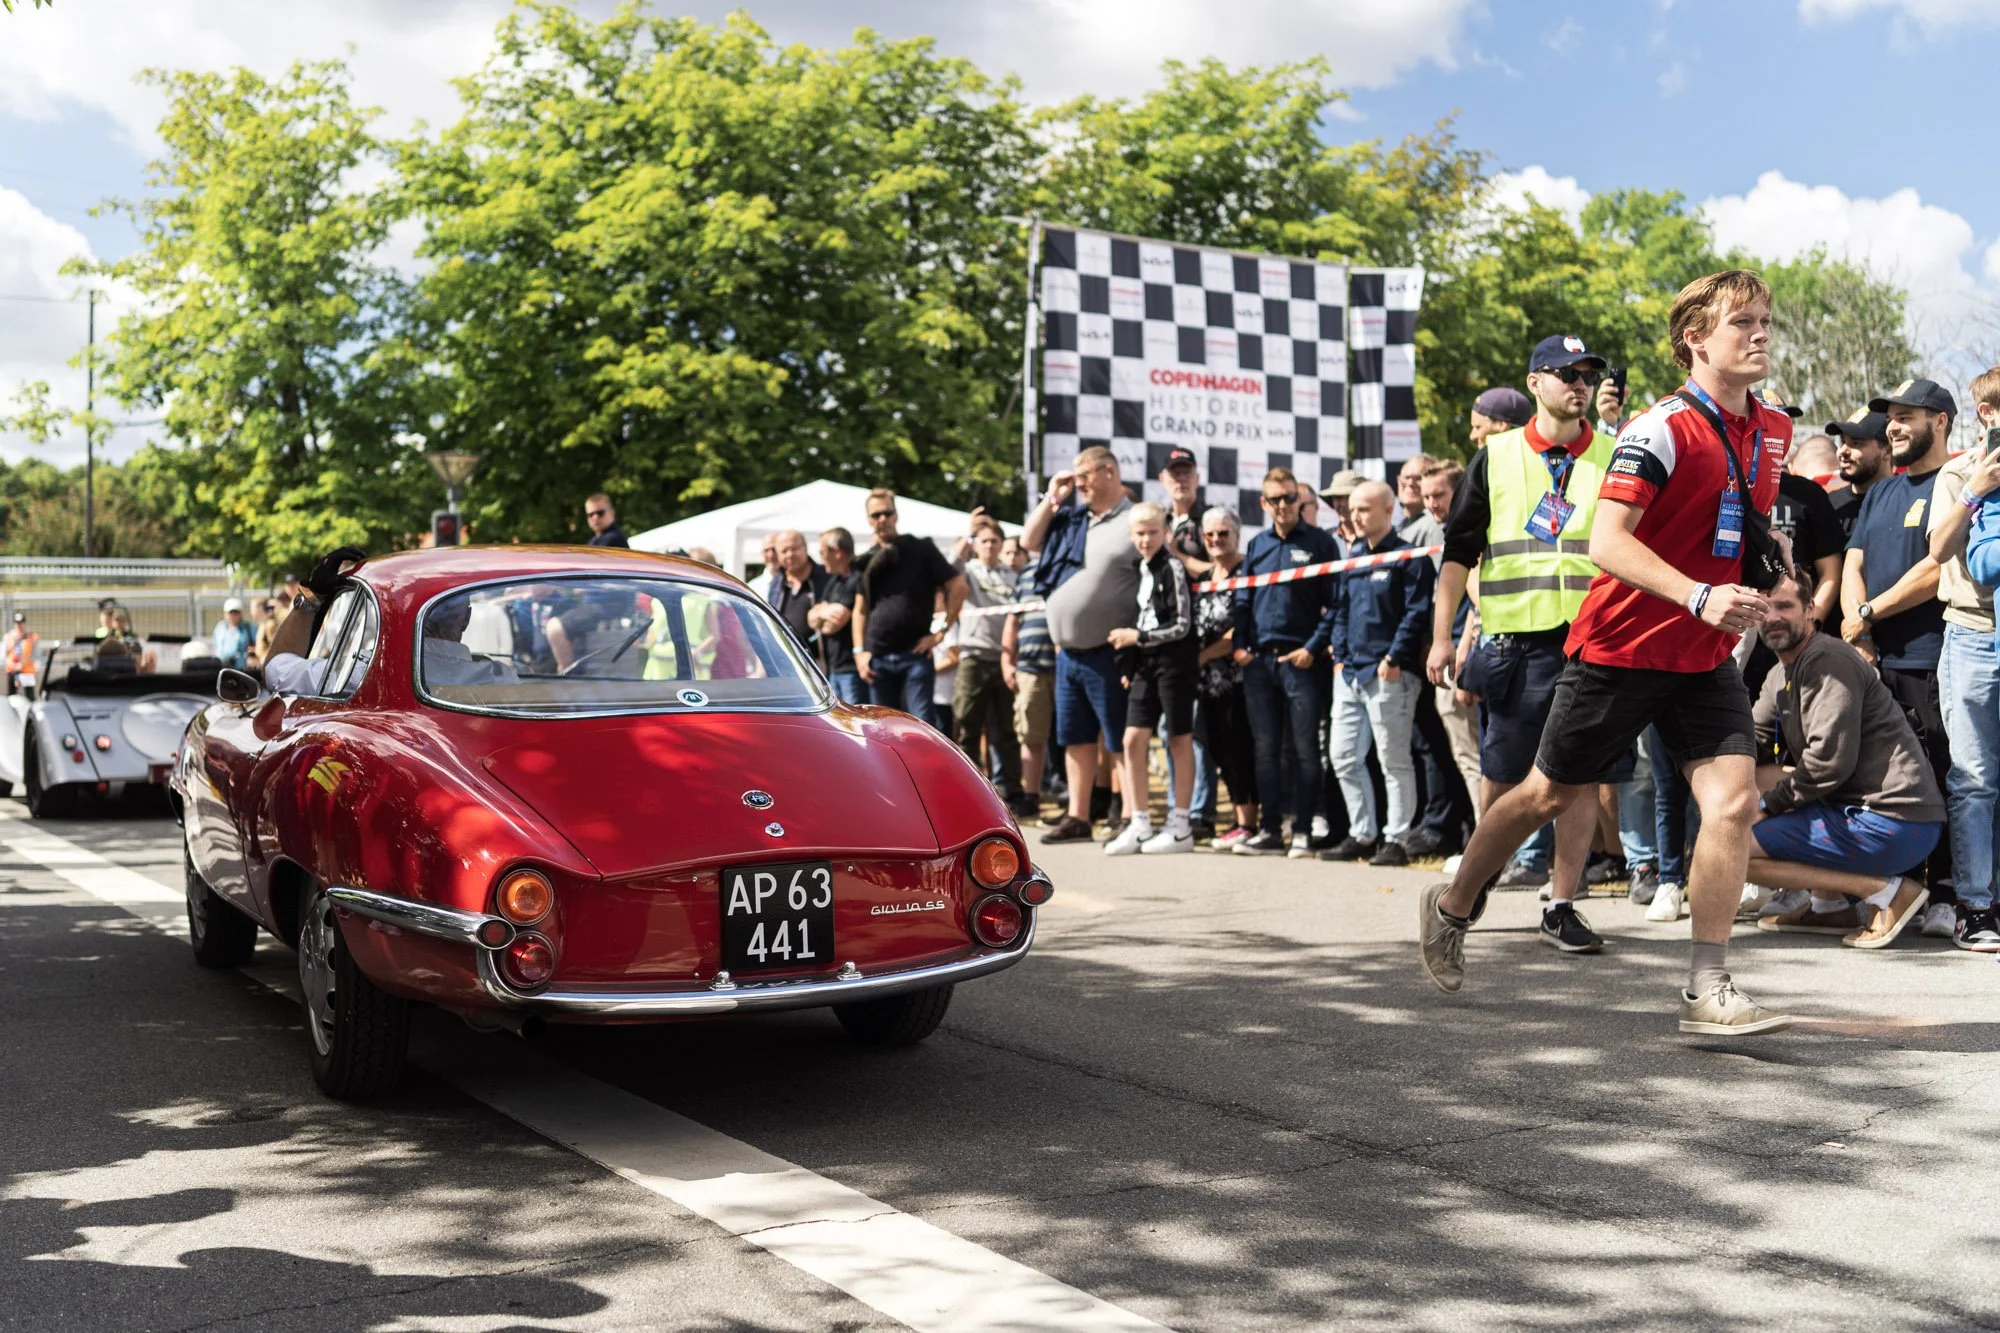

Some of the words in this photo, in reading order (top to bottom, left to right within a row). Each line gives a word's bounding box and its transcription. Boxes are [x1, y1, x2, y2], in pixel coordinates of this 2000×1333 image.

[1149, 368, 1263, 395] COPENHAGEN
[1150, 392, 1263, 418] HISTORIC
[1150, 415, 1217, 437] GRAND
[1224, 421, 1263, 440] PRIX
[727, 872, 778, 916] AP
[788, 868, 832, 910] 63
[870, 902, 921, 916] GIULIA
[923, 900, 946, 911] SS
[746, 918, 816, 963] 441
